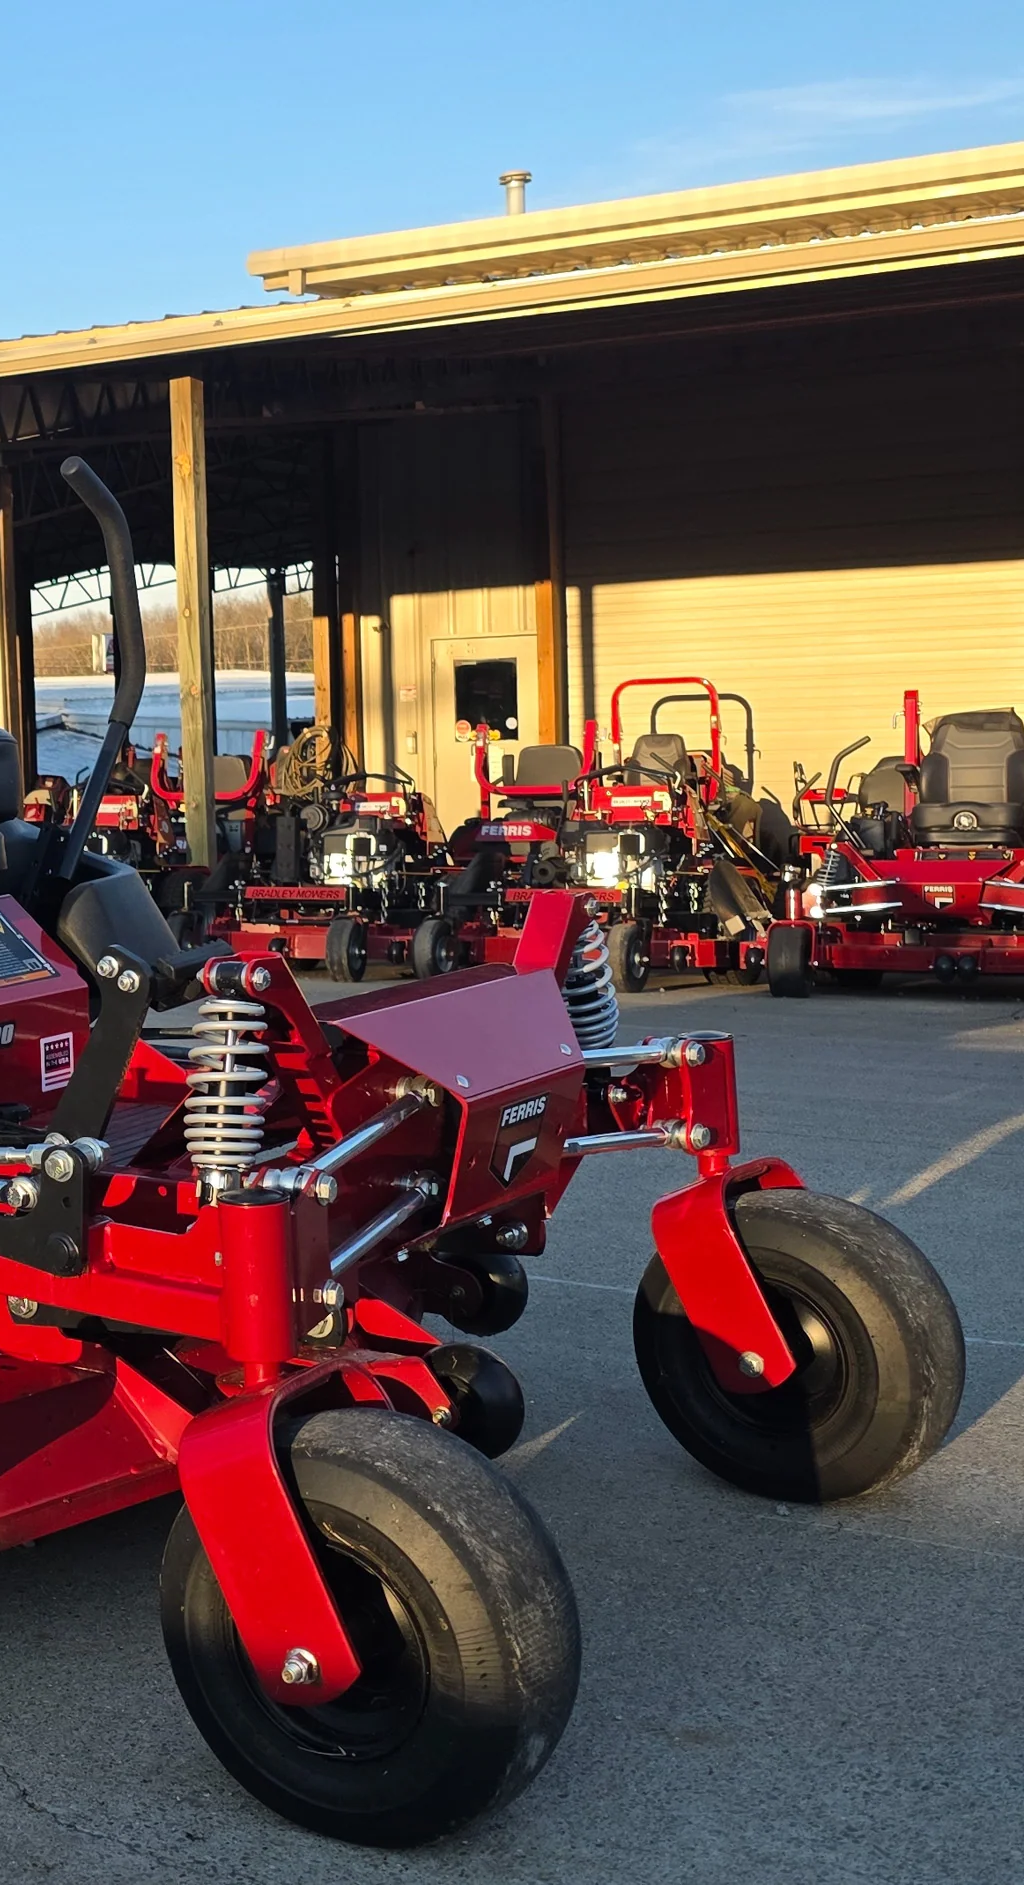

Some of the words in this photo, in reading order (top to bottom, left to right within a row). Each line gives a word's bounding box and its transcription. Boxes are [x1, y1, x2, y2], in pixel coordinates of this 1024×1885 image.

[481, 825, 532, 836] FERRIS
[252, 888, 294, 899] BRADLEY
[297, 889, 340, 899] MOWERS
[924, 885, 953, 893] FERRIS
[501, 1096, 547, 1127] FERRIS
